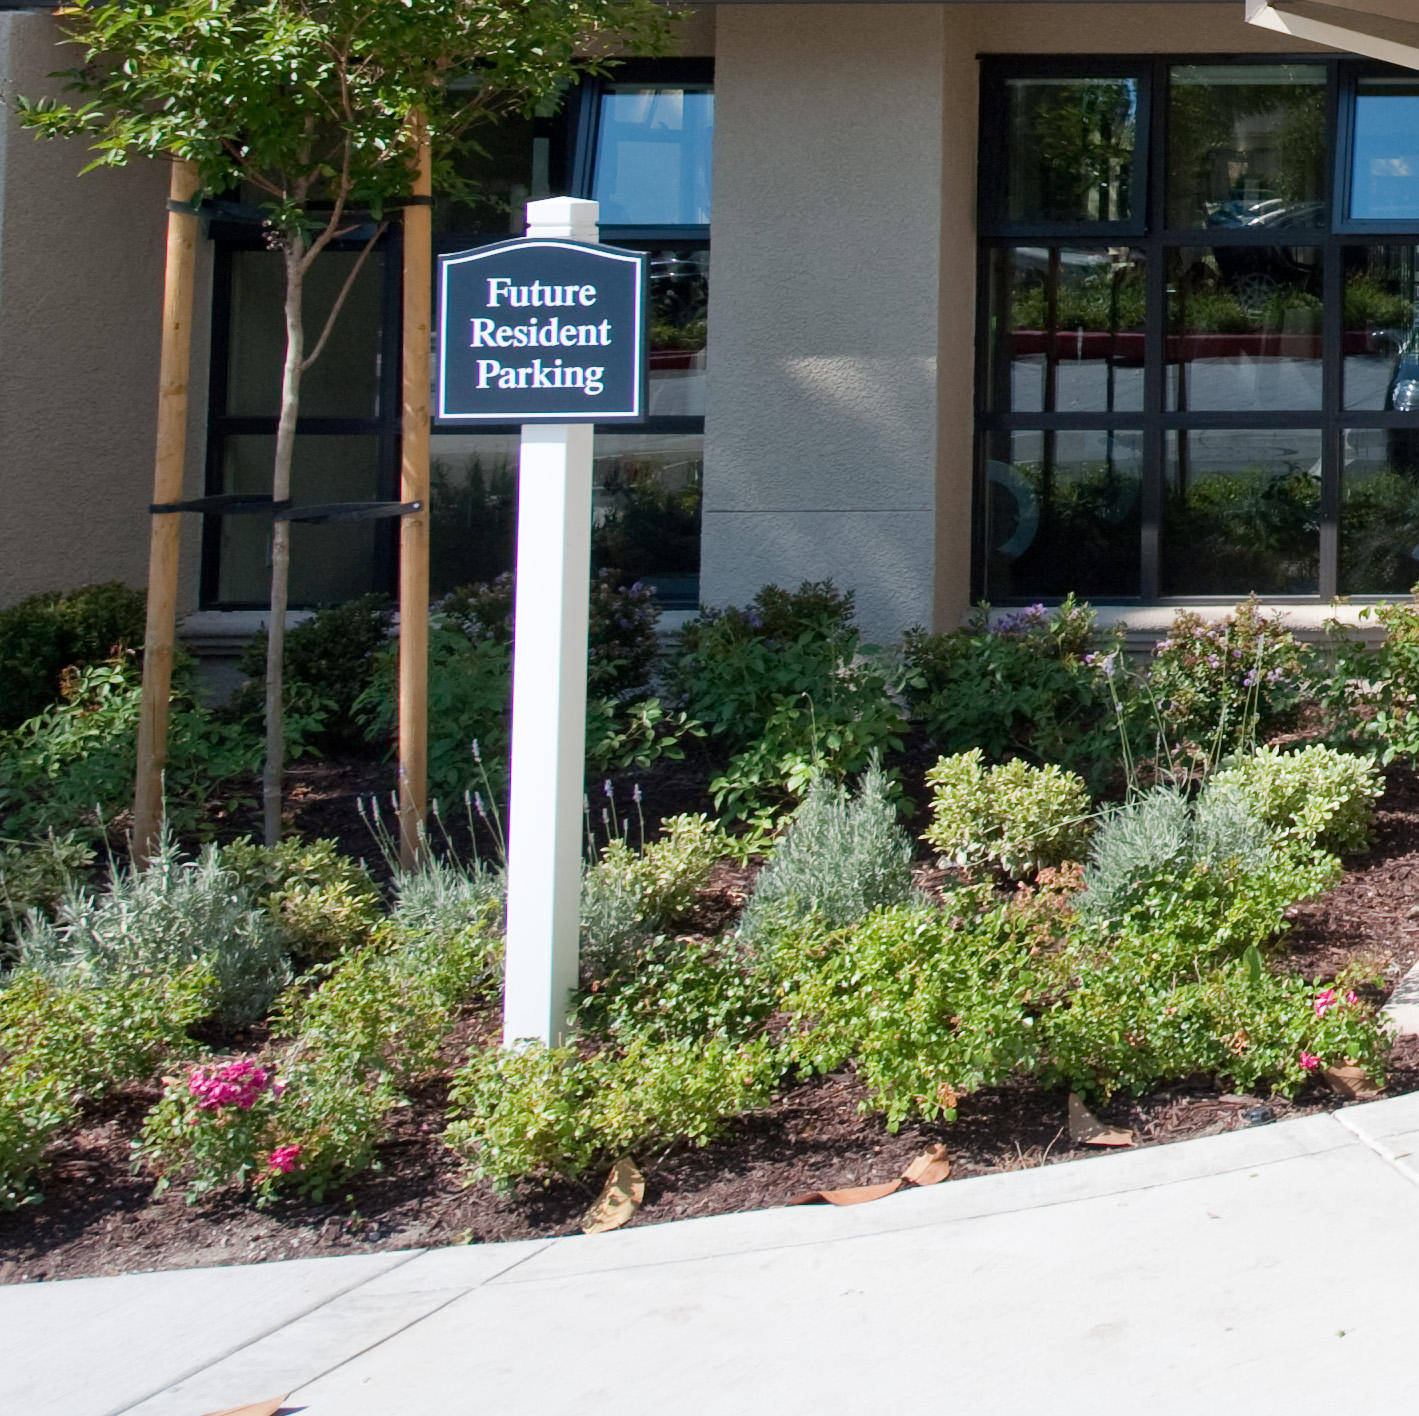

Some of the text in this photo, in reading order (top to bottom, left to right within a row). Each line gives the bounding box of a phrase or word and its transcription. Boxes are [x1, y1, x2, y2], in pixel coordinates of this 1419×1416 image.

[486, 277, 597, 307] Future
[470, 317, 612, 348] Resident
[475, 358, 605, 396] Parking
